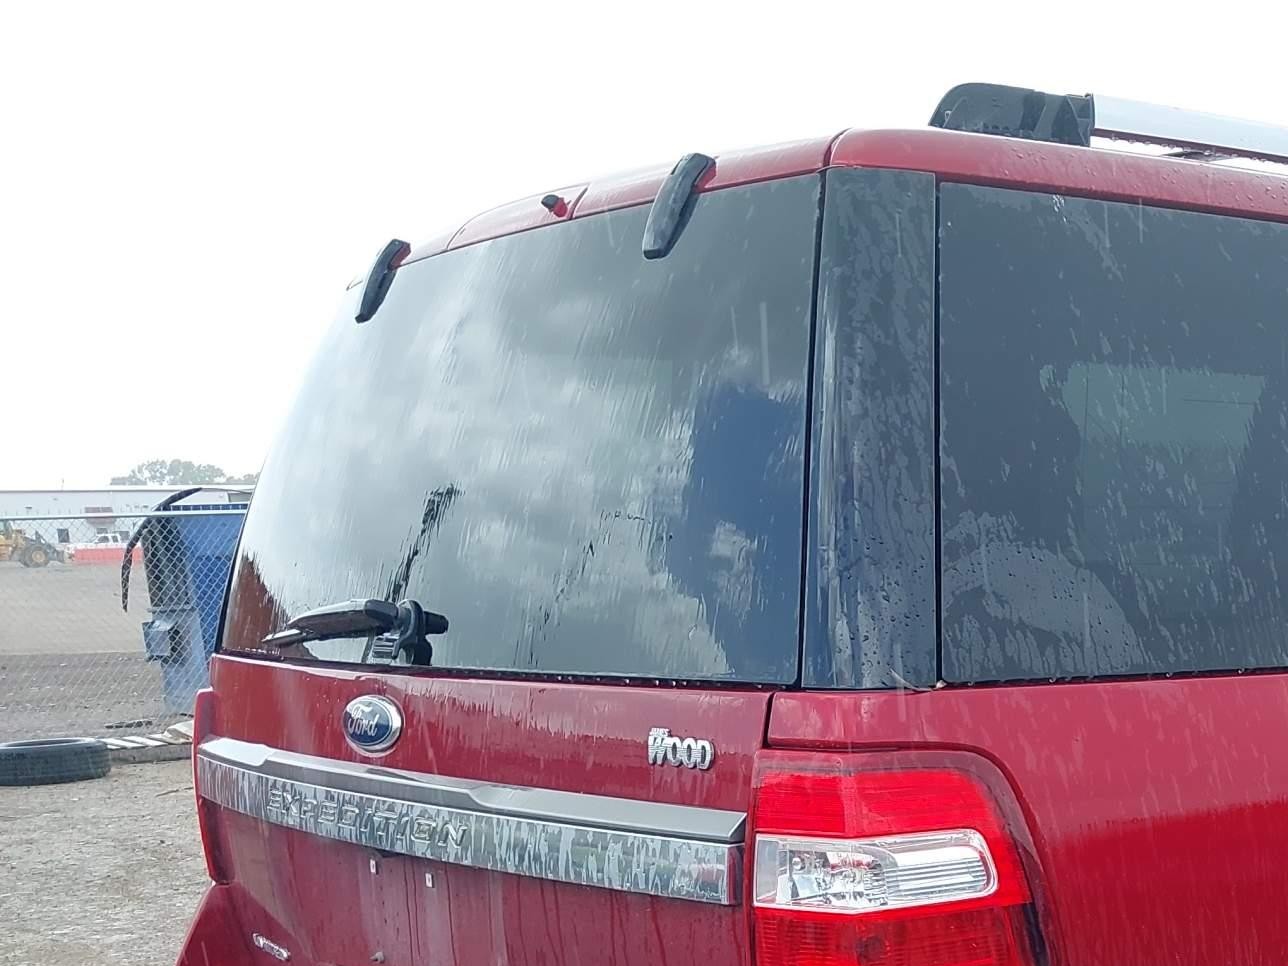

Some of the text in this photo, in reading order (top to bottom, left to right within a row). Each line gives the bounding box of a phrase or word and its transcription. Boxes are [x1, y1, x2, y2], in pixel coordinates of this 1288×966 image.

[347, 703, 379, 737] Ford
[647, 735, 714, 770] WOOD
[267, 789, 468, 848] EXPEDITION
